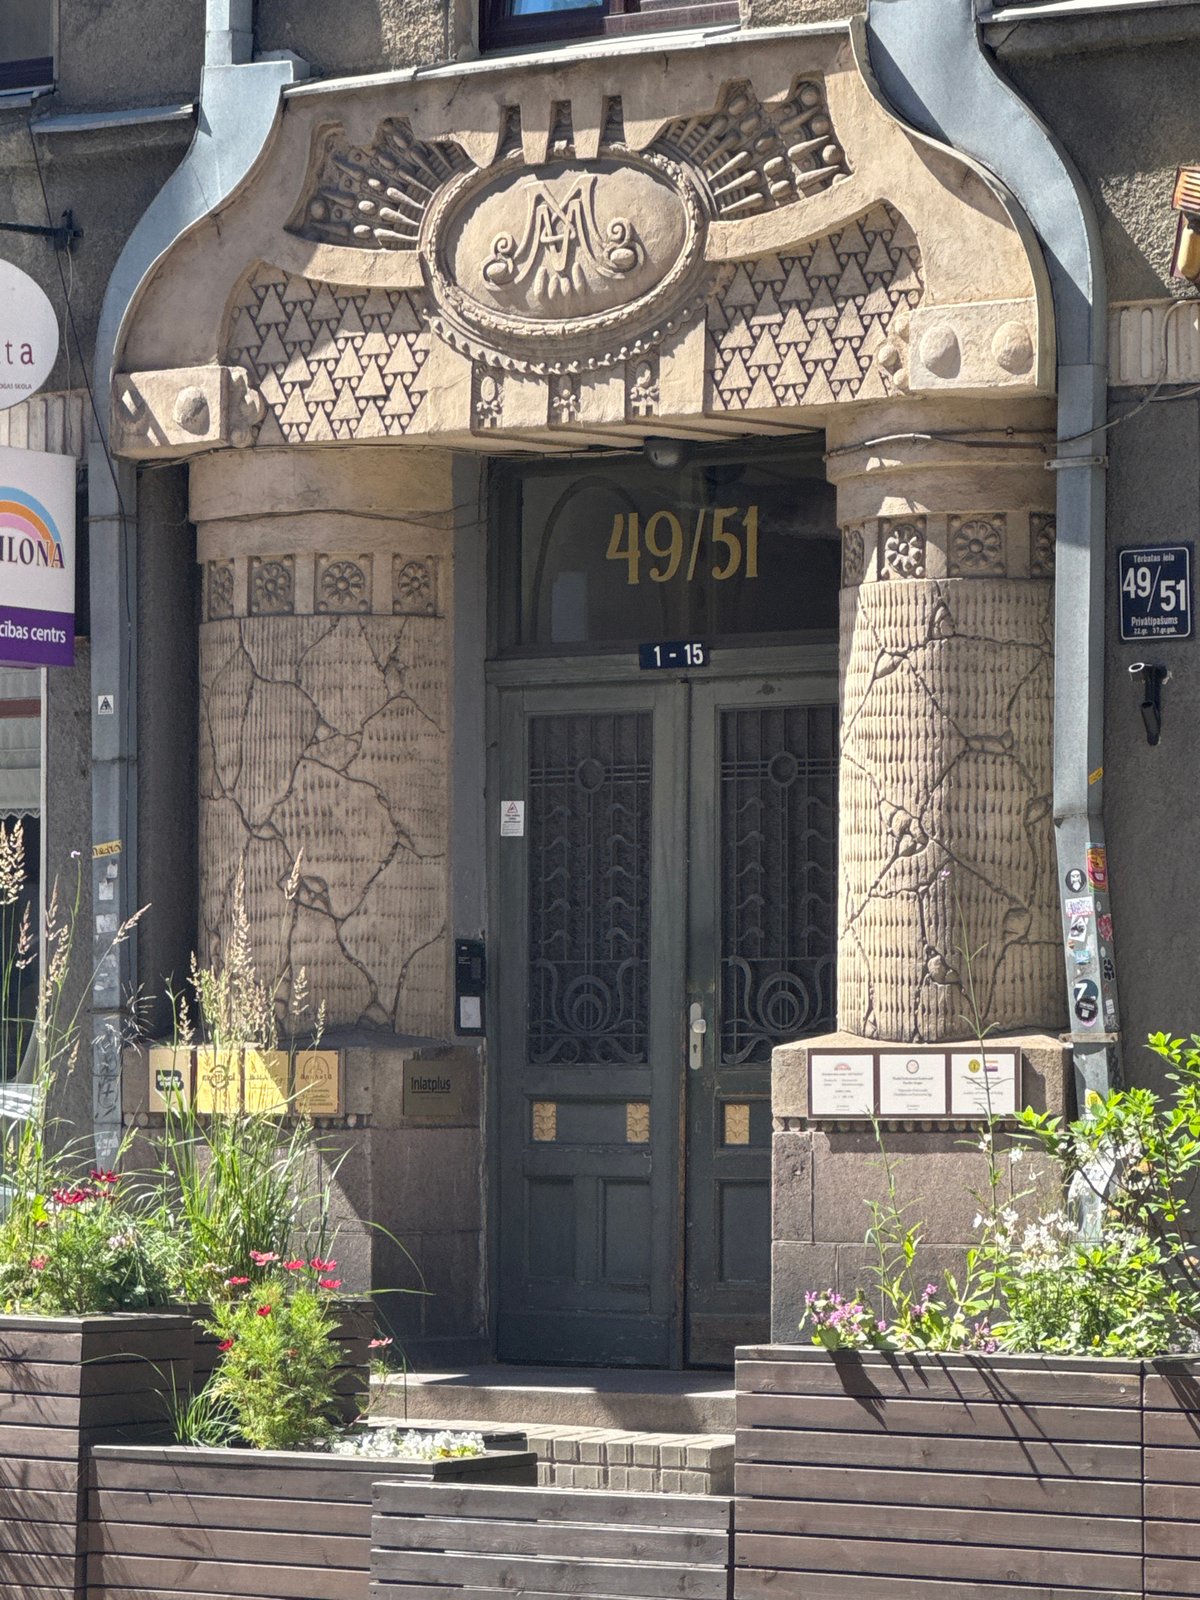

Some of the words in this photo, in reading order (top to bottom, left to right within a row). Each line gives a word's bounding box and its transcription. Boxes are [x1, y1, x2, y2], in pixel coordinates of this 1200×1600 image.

[605, 505, 759, 585] 49/51
[1122, 565, 1186, 612] 49/51
[31, 627, 66, 643] centrs
[653, 645, 661, 667] 1
[684, 643, 704, 665] 15
[411, 1075, 451, 1093] Inlatplus
